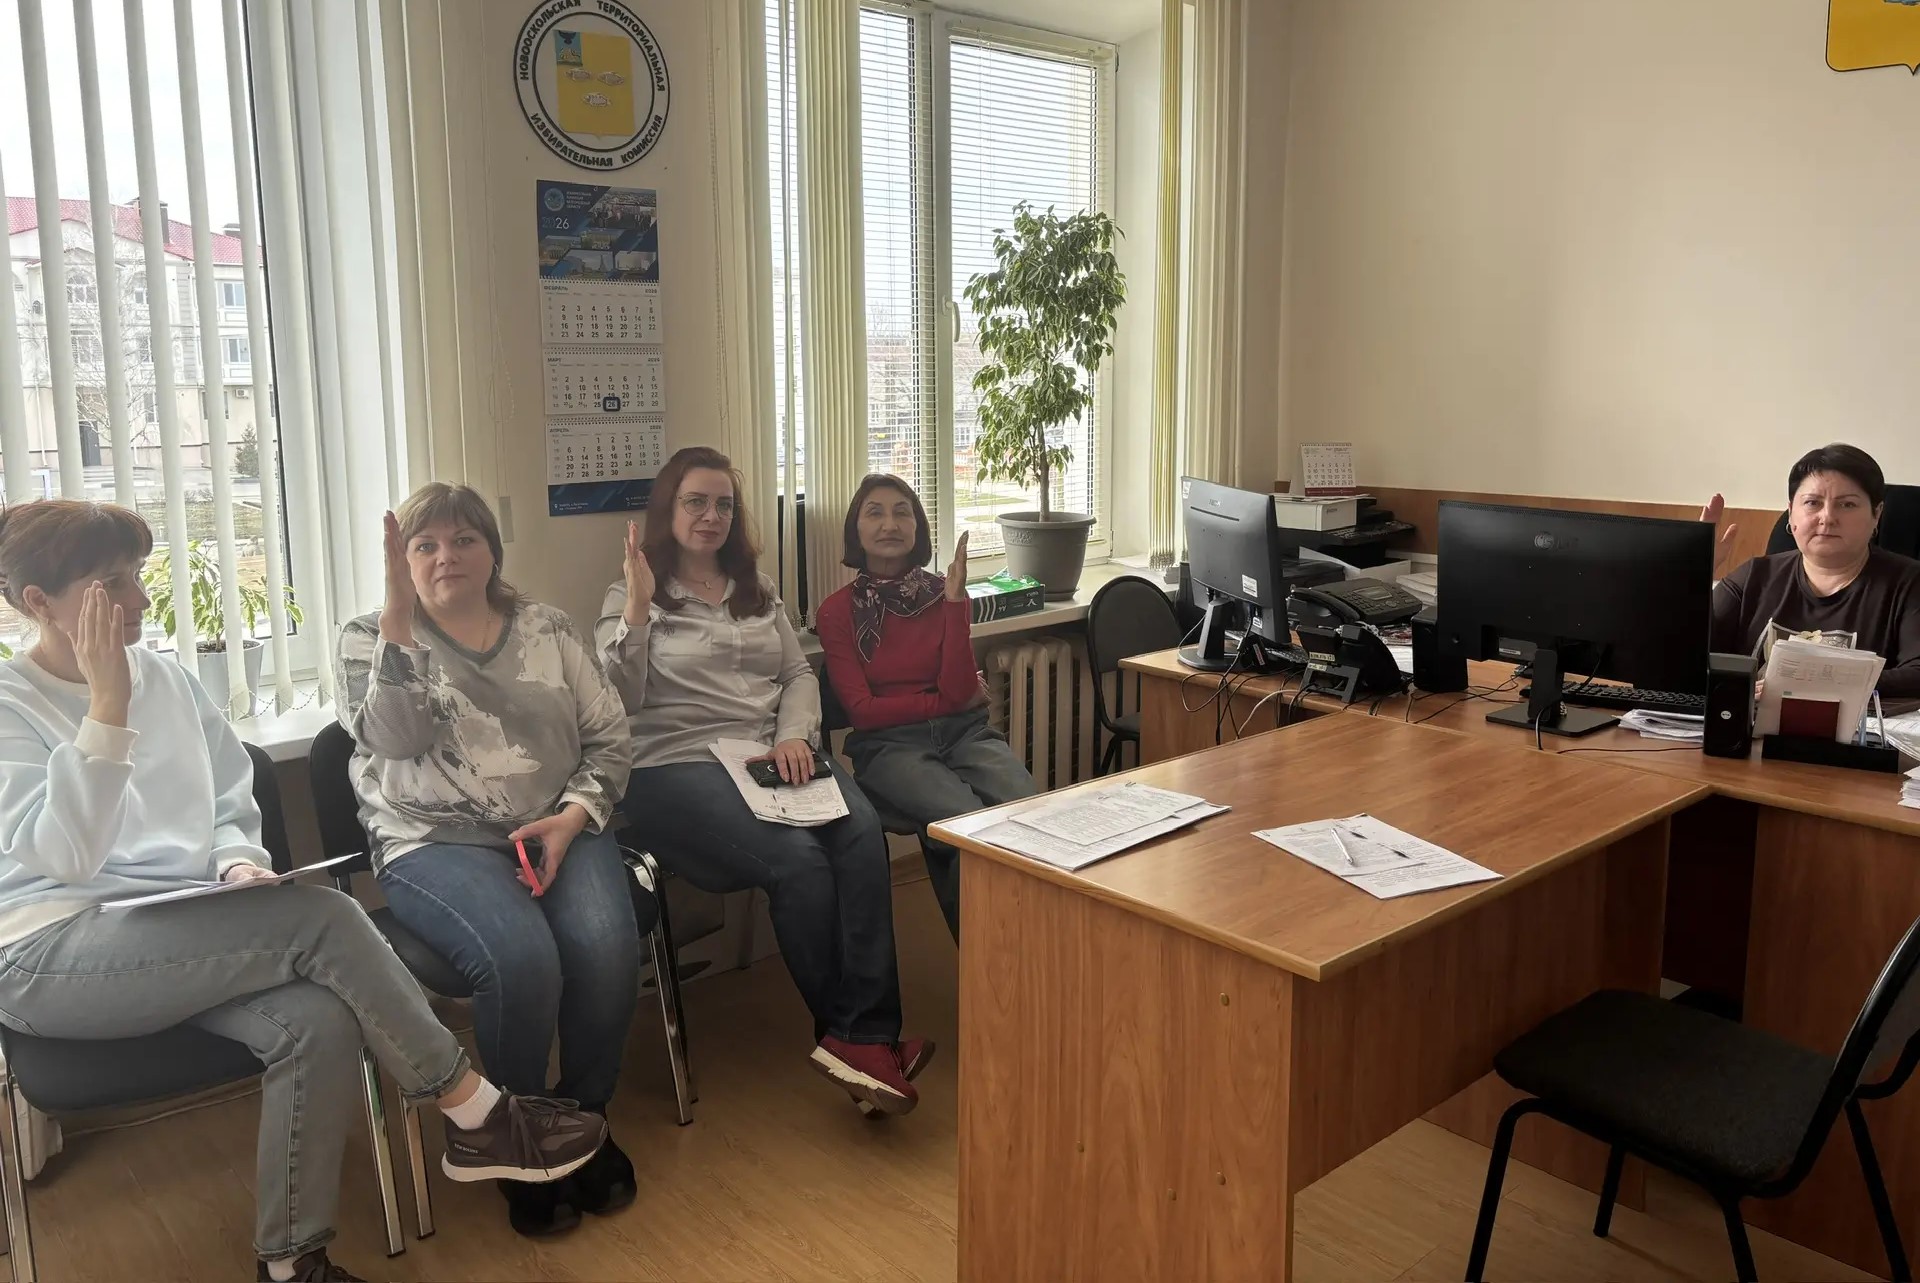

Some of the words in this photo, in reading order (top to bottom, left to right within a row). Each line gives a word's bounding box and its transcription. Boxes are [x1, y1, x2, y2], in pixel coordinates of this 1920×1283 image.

[520, 0, 580, 80] НОВООСКОЛЬСКАЯ
[597, 0, 665, 91] ТЕРРИТОРИАЛЬНАЯ
[530, 113, 612, 166] ИЗБИРАТЕЛЬНАЯ
[621, 115, 663, 163] КОМИССИЯ
